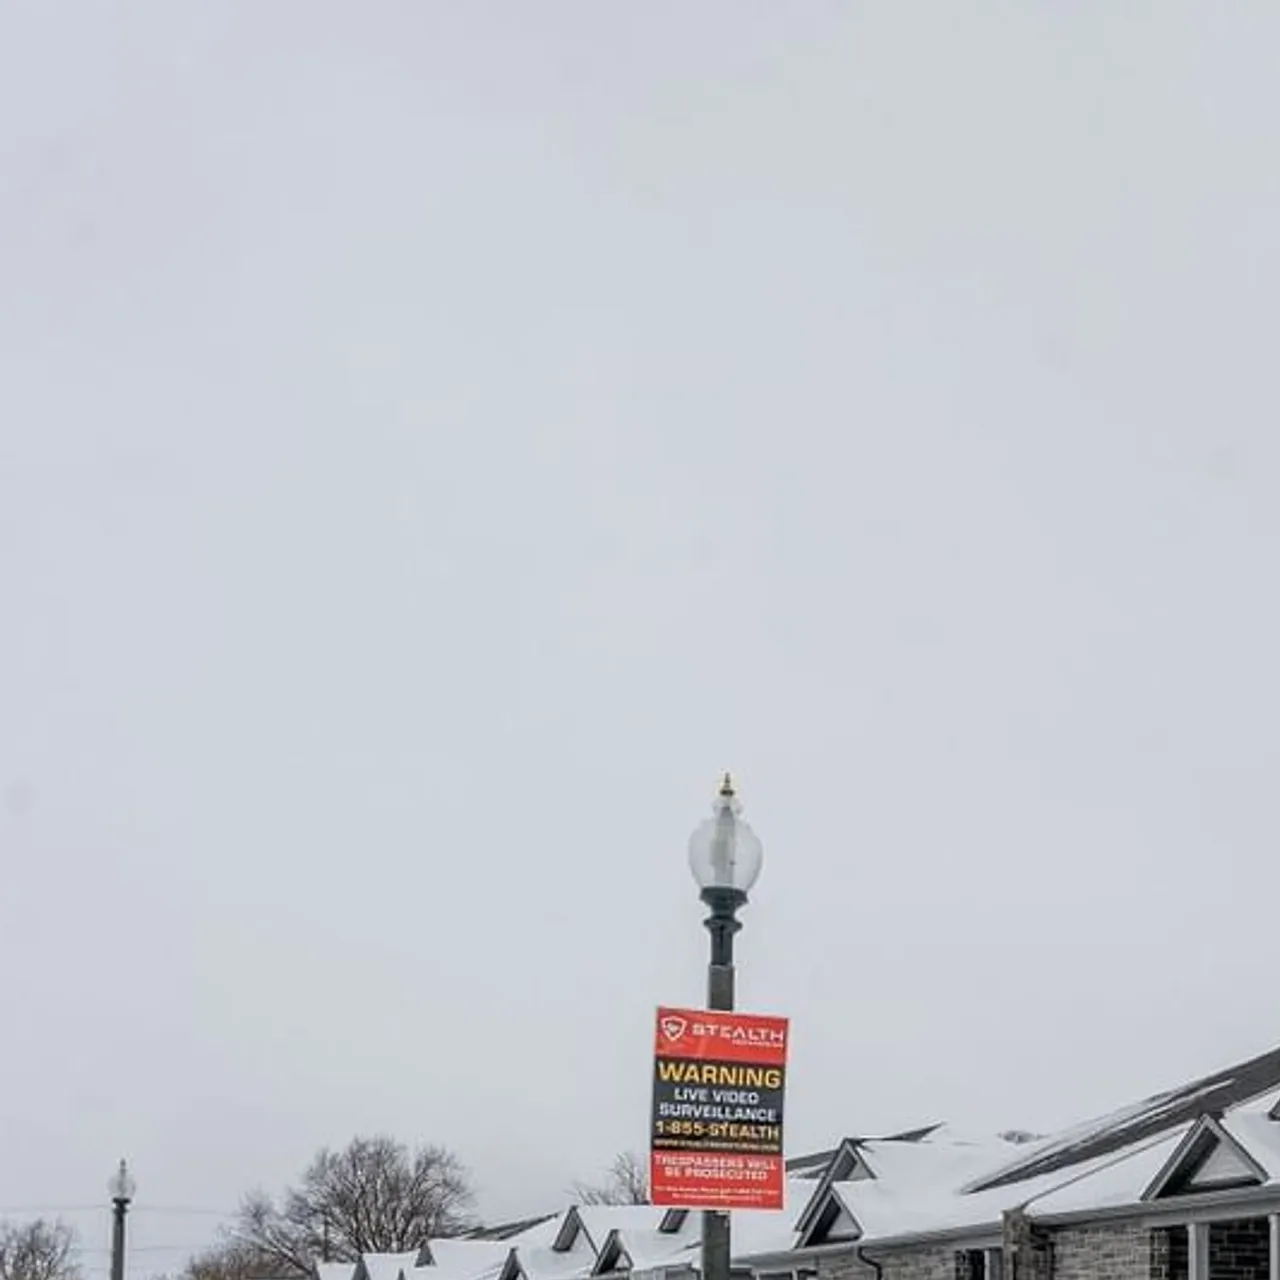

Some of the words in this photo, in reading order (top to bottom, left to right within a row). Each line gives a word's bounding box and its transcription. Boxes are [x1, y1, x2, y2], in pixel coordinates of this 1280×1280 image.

[692, 1022, 784, 1041] STEALTH
[659, 1063, 781, 1089] WARNING
[674, 1087, 707, 1102] LIVE
[712, 1089, 760, 1105] VIDEO
[659, 1102, 777, 1121] SURVEILLANCE
[655, 1120, 780, 1140] 1-855-STEALTH
